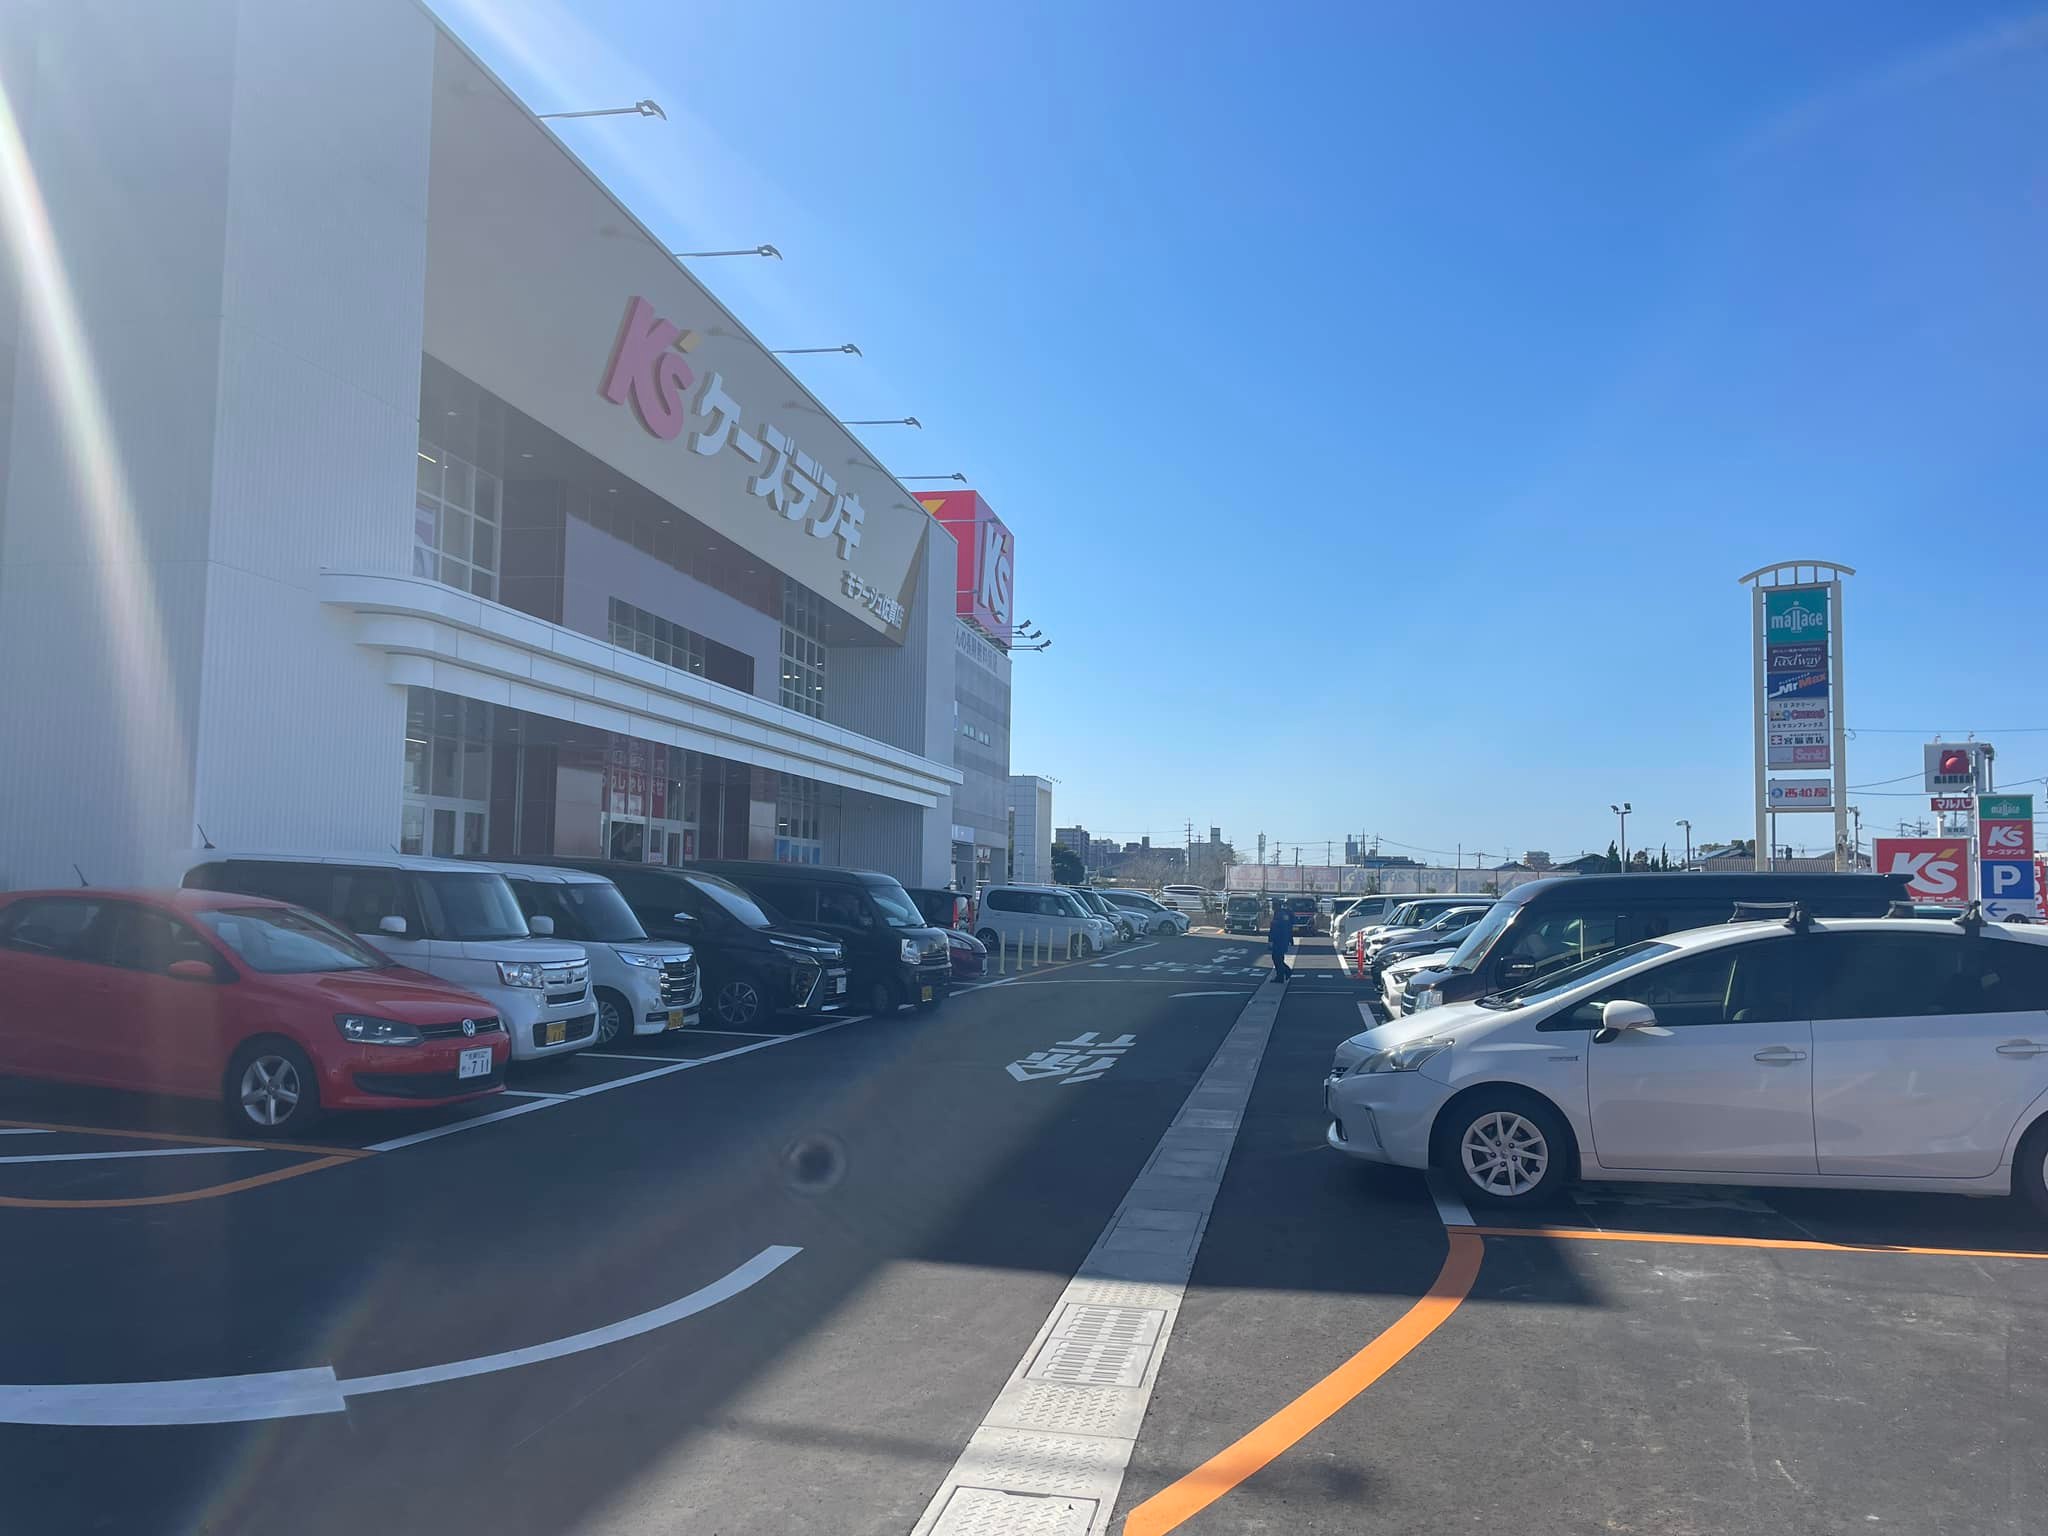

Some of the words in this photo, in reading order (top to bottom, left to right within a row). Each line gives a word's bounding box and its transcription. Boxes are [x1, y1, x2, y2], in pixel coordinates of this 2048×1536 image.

[690, 371, 865, 560] ケーズデンキ
[1993, 865, 2021, 894] P
